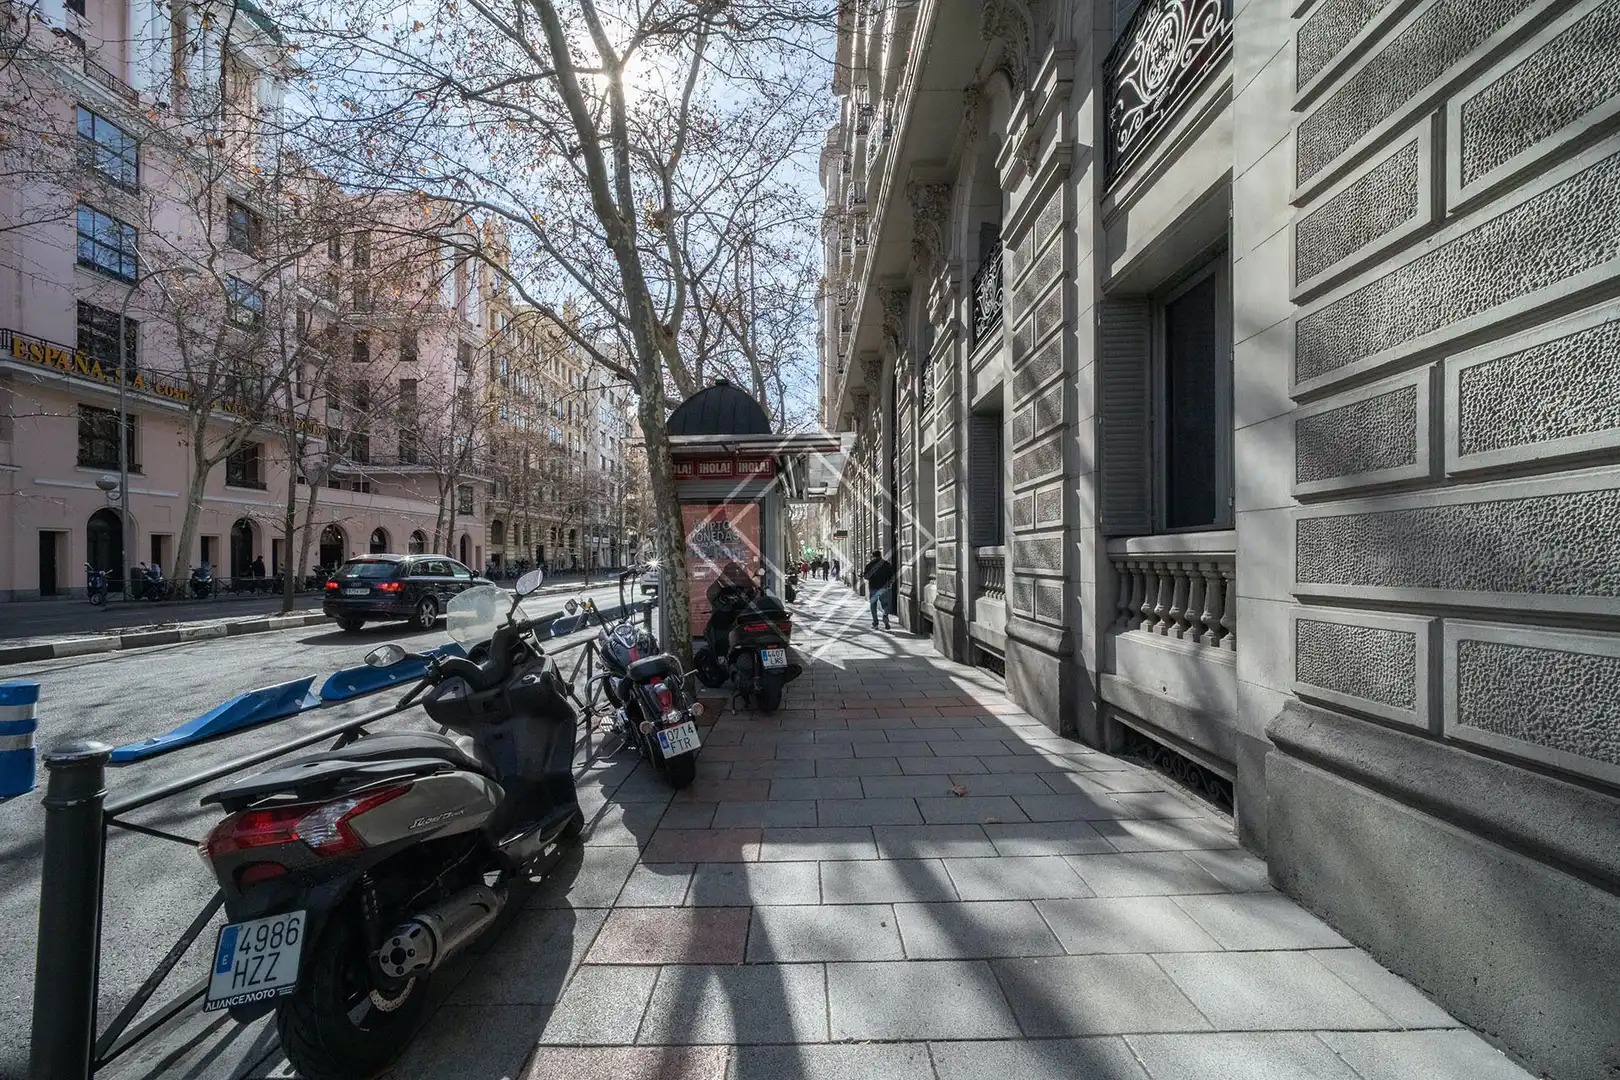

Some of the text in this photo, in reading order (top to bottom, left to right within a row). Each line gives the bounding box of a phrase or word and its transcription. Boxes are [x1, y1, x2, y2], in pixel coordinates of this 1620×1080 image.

[699, 462, 731, 474] ¡HOLA!
[738, 461, 770, 473] ¡HOLA!
[666, 724, 694, 742] 0714
[670, 736, 692, 754] FTR
[239, 917, 300, 955] 4986
[221, 954, 229, 966] E
[231, 951, 281, 990] HZZ
[204, 988, 276, 1012] ALIANCEMOTO
